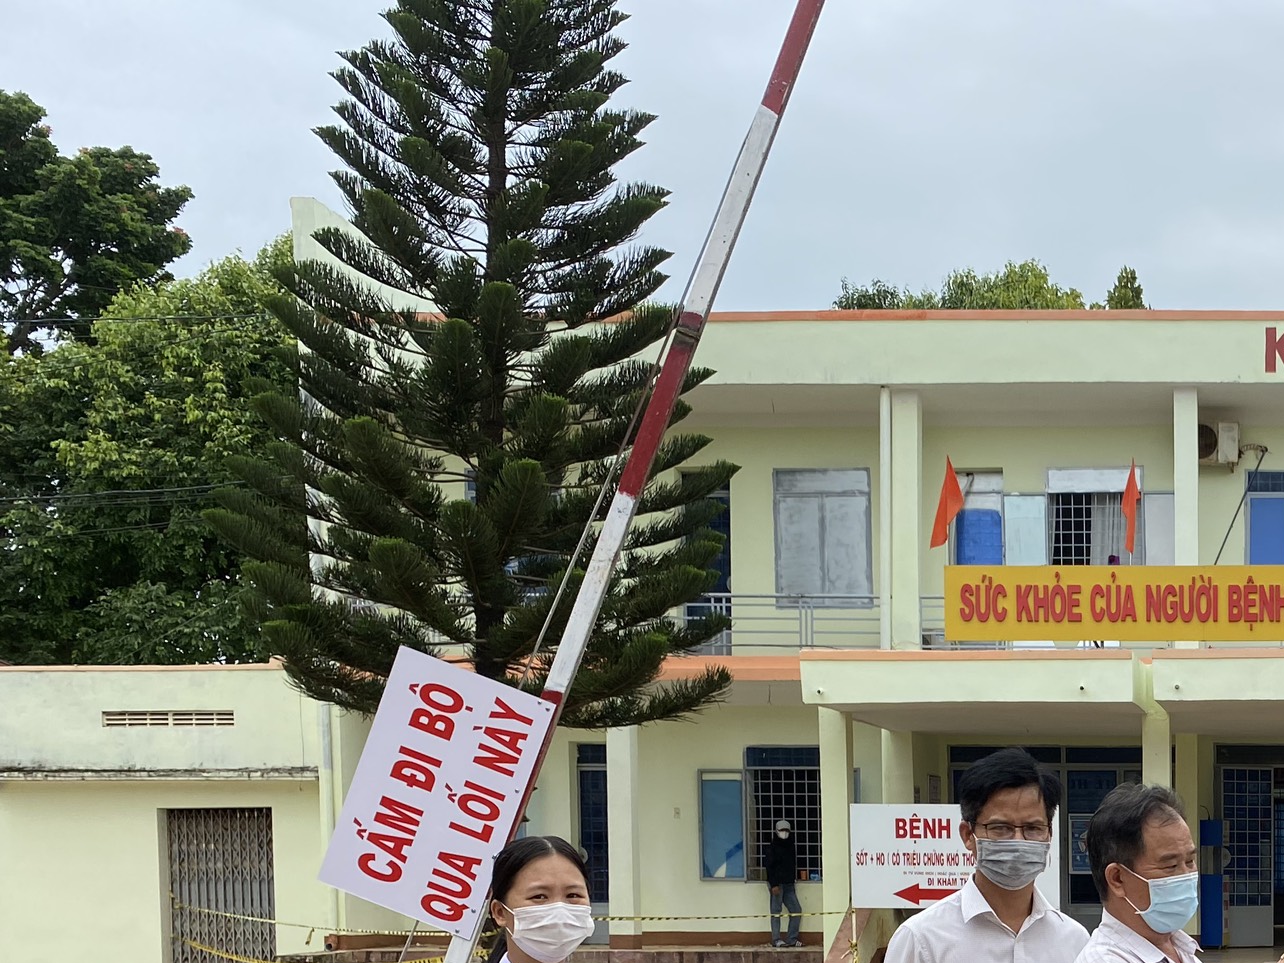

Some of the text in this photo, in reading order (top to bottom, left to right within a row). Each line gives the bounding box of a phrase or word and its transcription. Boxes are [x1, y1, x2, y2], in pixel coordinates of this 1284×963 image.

[960, 574, 1007, 622] SỨC
[1016, 571, 1082, 623] KHỎE
[1090, 571, 1137, 622] CỦA
[1146, 574, 1219, 622] NGƯỜI
[354, 682, 473, 883] CẤM ĐI BỘ
[420, 696, 534, 922] QUA LỐI NÀY
[895, 813, 951, 844] BỆNH
[856, 848, 868, 866] SỐT
[876, 852, 885, 866] HO
[892, 849, 900, 866] CÓ
